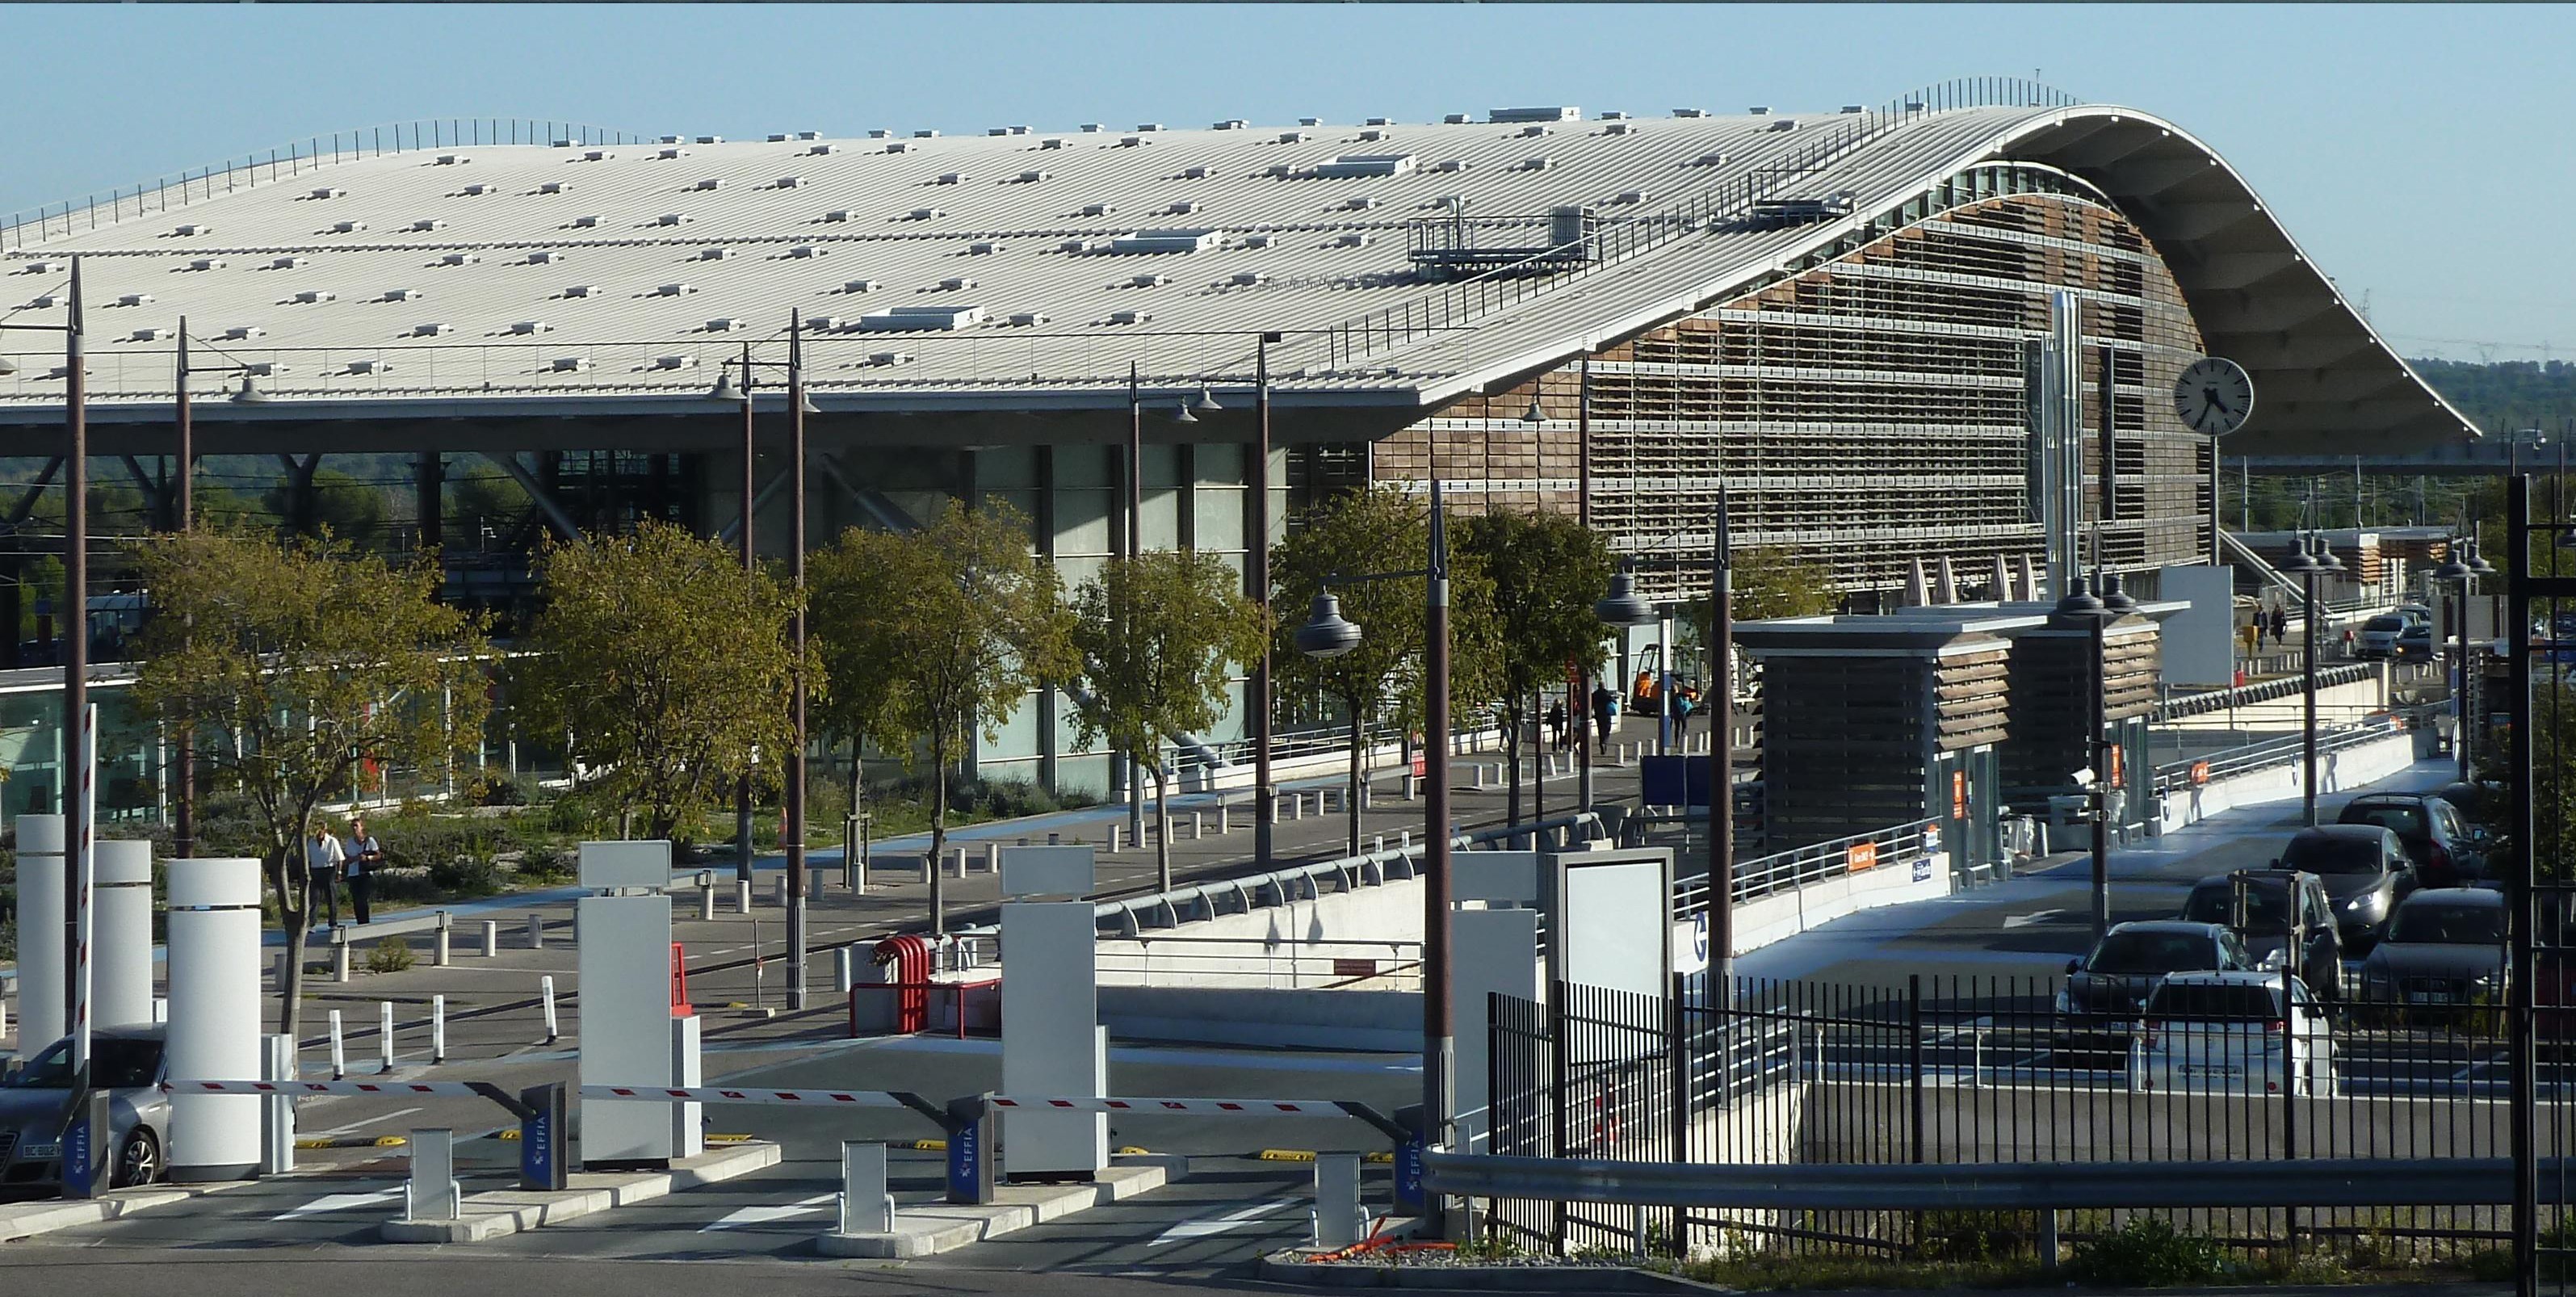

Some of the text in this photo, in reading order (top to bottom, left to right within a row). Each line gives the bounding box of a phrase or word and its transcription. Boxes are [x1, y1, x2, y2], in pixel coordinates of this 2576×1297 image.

[77, 1125, 86, 1160] EFFIA
[537, 1116, 546, 1150] EFFIA
[963, 1127, 973, 1162] EFFIA
